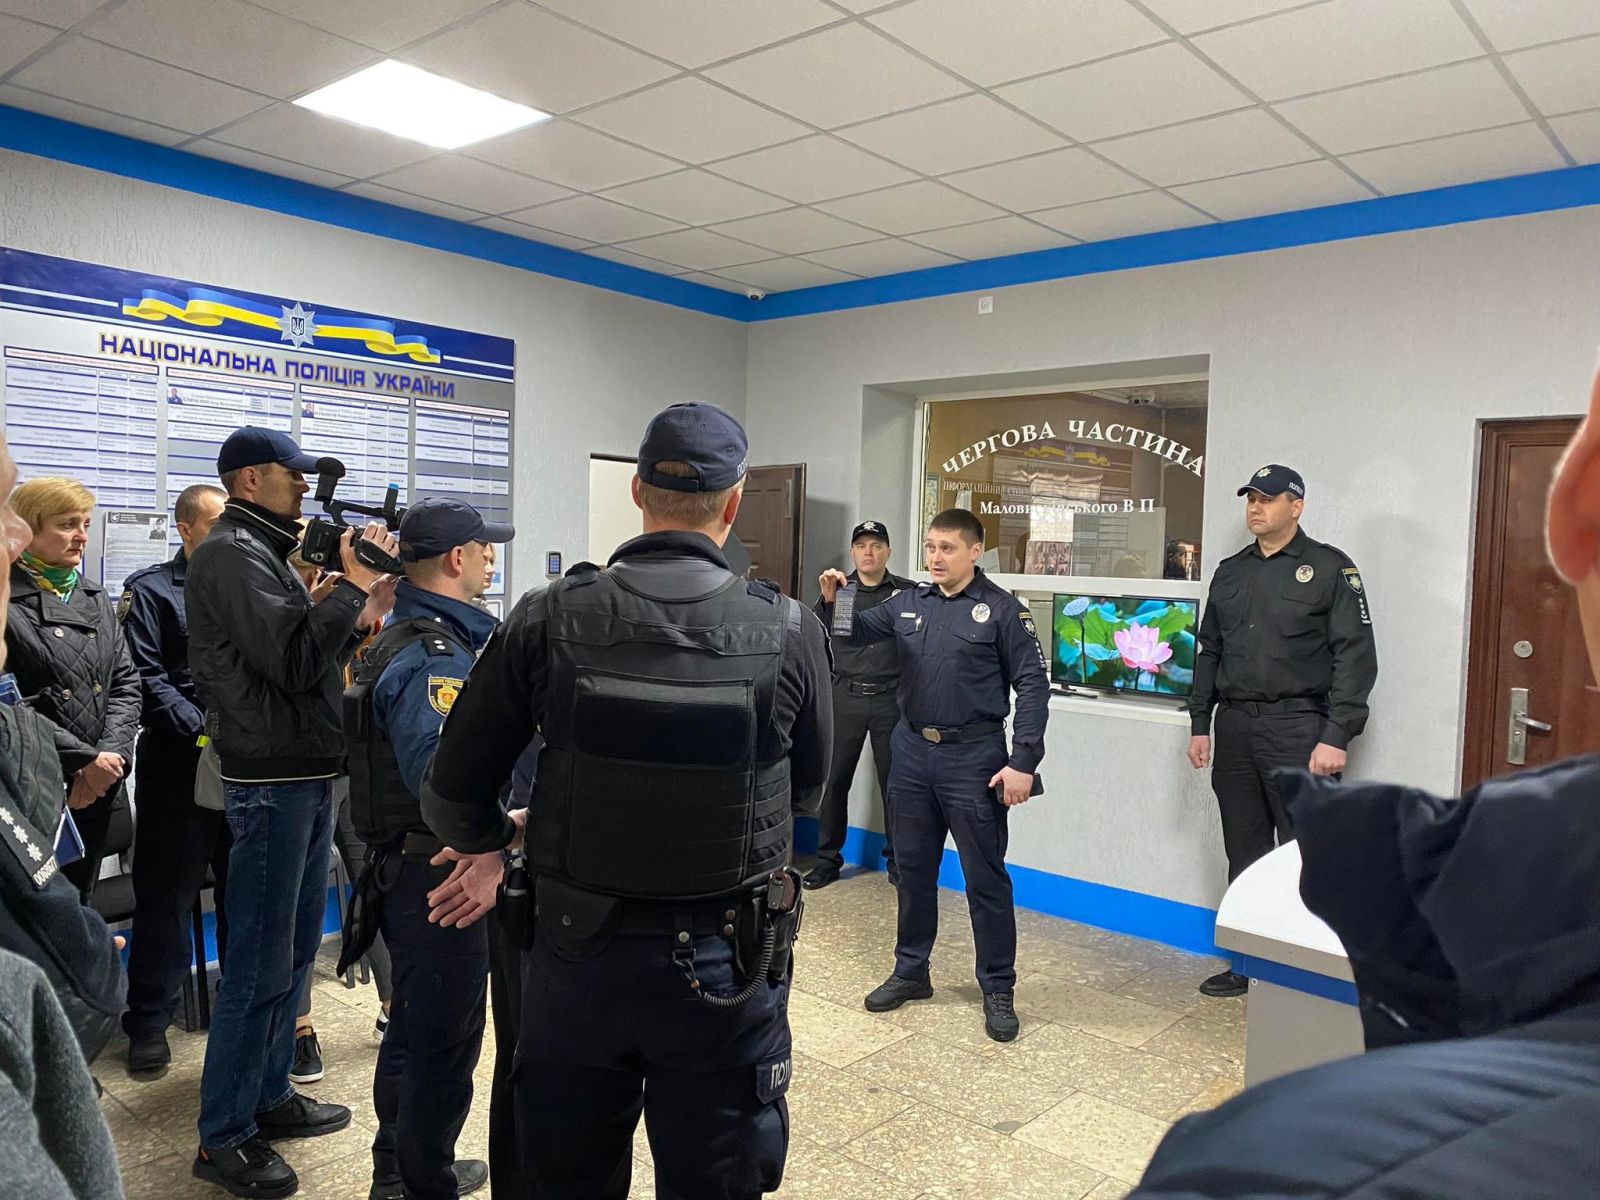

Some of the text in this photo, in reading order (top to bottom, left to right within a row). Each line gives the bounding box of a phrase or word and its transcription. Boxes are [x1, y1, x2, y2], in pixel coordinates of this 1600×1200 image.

[99, 333, 278, 376] НАЦІОНАЛЬНА
[284, 359, 367, 387] ПОЛІЦІЯ
[373, 370, 457, 399] УКРАЇНИ
[941, 419, 1205, 478] ЧЕРГОВА ЧАСТИНА
[1121, 498, 1134, 513] В
[1139, 498, 1156, 513] П
